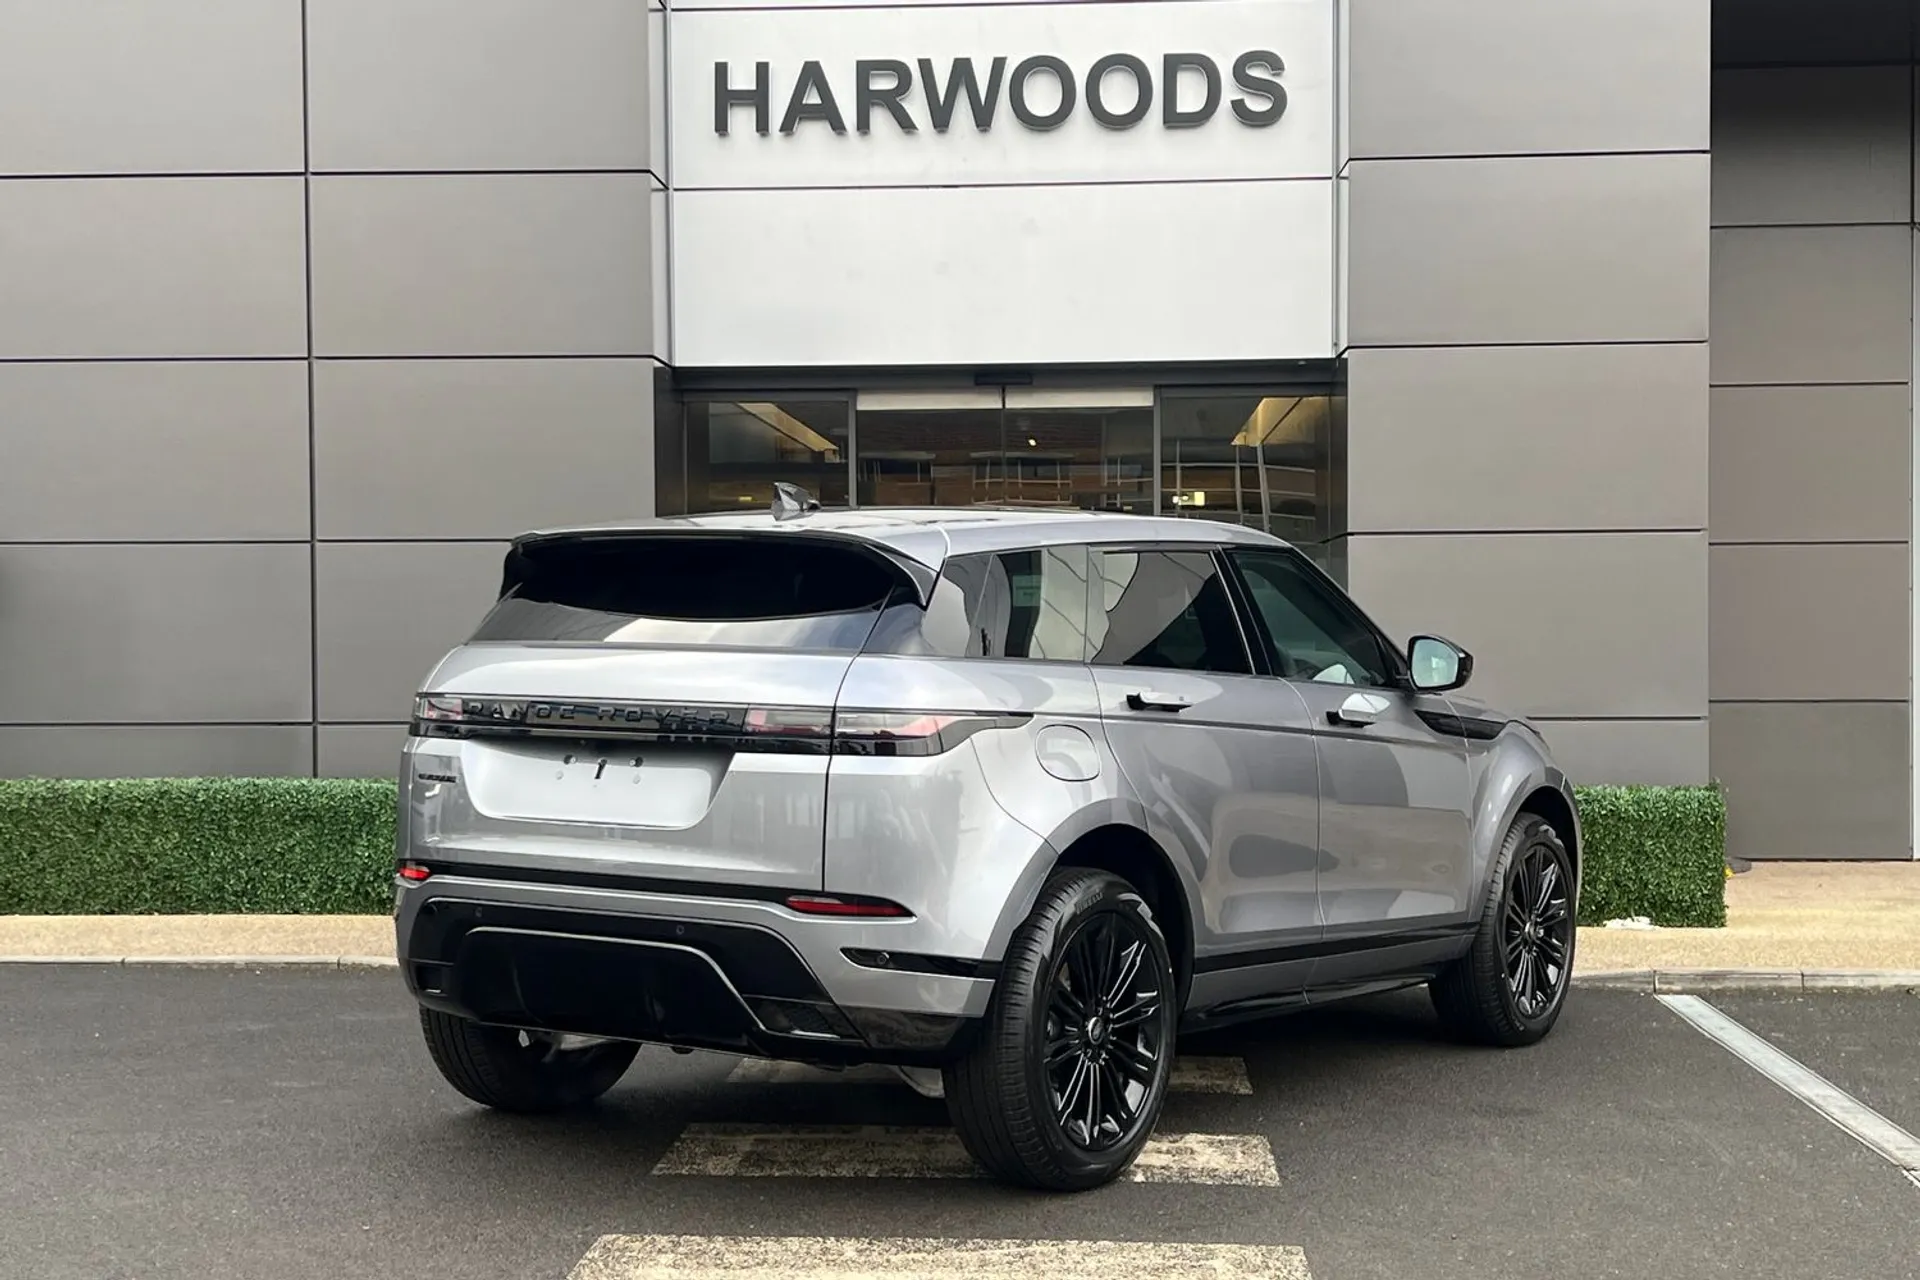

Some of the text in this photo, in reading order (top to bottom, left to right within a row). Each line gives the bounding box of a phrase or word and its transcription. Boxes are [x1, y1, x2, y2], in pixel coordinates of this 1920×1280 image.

[714, 50, 1288, 136] HARWOODS
[467, 701, 730, 726] RANGE ROVER
